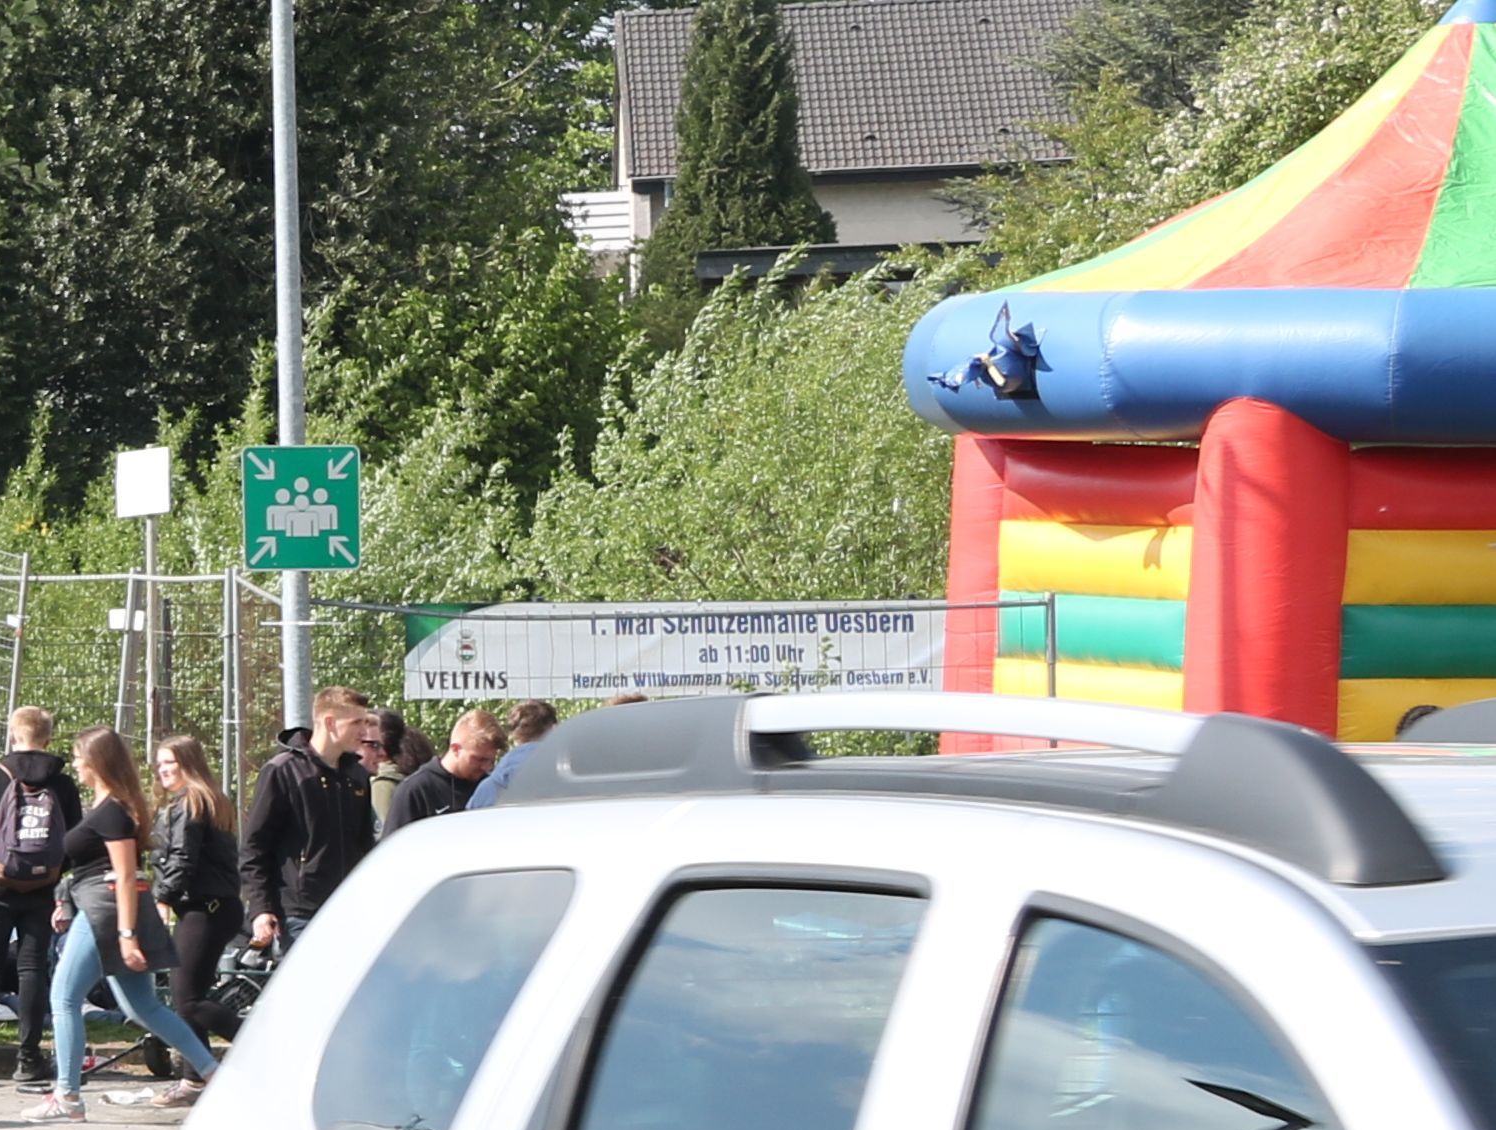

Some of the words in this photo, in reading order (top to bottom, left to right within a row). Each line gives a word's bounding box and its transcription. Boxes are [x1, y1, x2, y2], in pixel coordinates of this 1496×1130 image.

[825, 610, 915, 633] Oesbern
[699, 645, 719, 664] ab
[724, 645, 771, 664] 11:00
[776, 644, 805, 663] Uhr
[424, 671, 508, 690] VELTINS
[572, 673, 628, 689] Herzlich
[633, 671, 722, 688] Willkommen
[847, 668, 903, 686] Oesbern
[908, 667, 932, 684] e.V.
